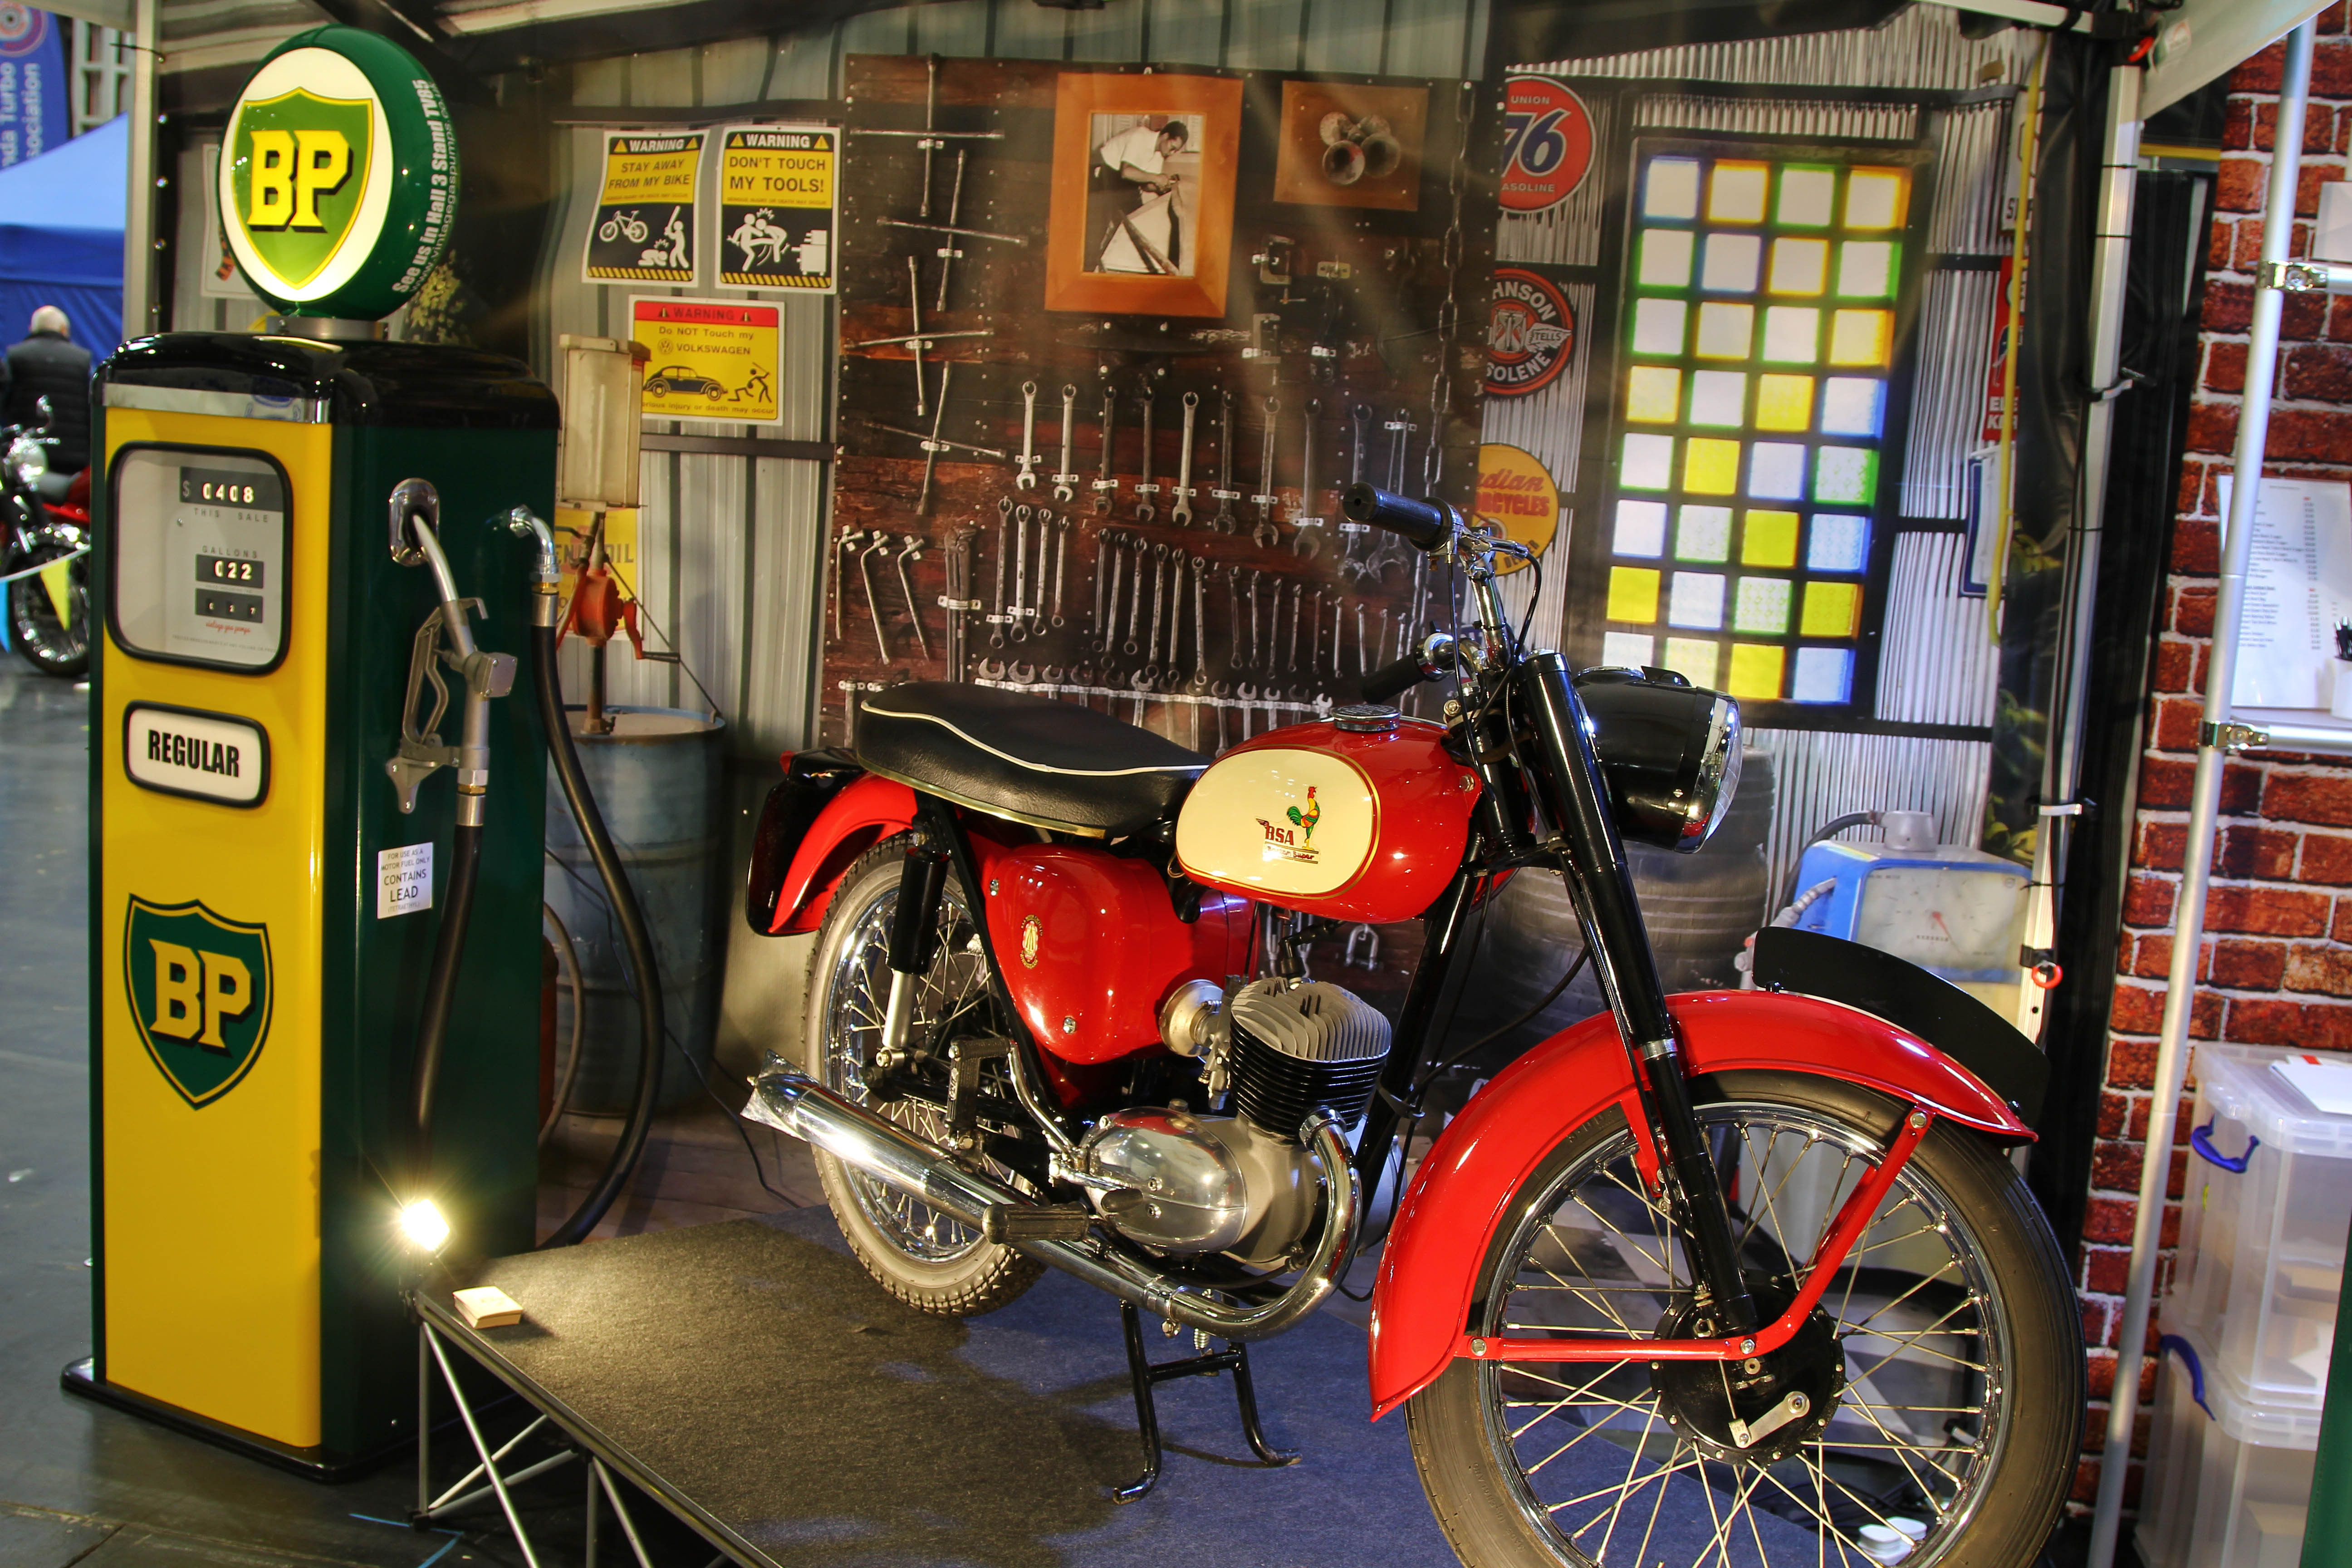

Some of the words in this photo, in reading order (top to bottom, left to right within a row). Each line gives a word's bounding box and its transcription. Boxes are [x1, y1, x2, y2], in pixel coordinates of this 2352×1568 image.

[412, 78, 441, 118] TV85
[1511, 96, 1550, 104] UNION
[426, 119, 449, 172] Stand
[629, 139, 684, 152] WARNING
[746, 133, 810, 148] WARNING
[1502, 108, 1571, 177] 76
[621, 161, 649, 173] STAY
[652, 158, 685, 170] AWAY
[730, 157, 772, 168] DON'T
[779, 157, 826, 170] TOUCH
[246, 130, 350, 227] BP
[431, 173, 448, 186] 3
[608, 179, 640, 189] FROM
[643, 177, 661, 186] MY
[663, 174, 691, 185] BIKE
[730, 176, 756, 189] MY
[764, 177, 824, 192] TOOLS!
[426, 187, 446, 224] Hall
[420, 226, 439, 243] in
[412, 245, 431, 265] us
[392, 262, 421, 294] See
[673, 306, 734, 321] WARNING
[659, 326, 672, 334] Do
[677, 327, 698, 335] NOT
[704, 329, 734, 338] Touch
[676, 343, 750, 355] VOLKSWAGEN
[668, 402, 690, 411] injury
[194, 508, 220, 518] THIS
[238, 512, 269, 523] SALE
[202, 545, 257, 559] GALLONS
[147, 730, 240, 777] REGULAR
[1265, 825, 1294, 846] BSA
[1293, 851, 1314, 859] Super
[381, 862, 399, 870] MOTOR
[384, 868, 426, 886] CONTAINS
[390, 886, 418, 902] LEAD
[149, 939, 250, 1049] BP
